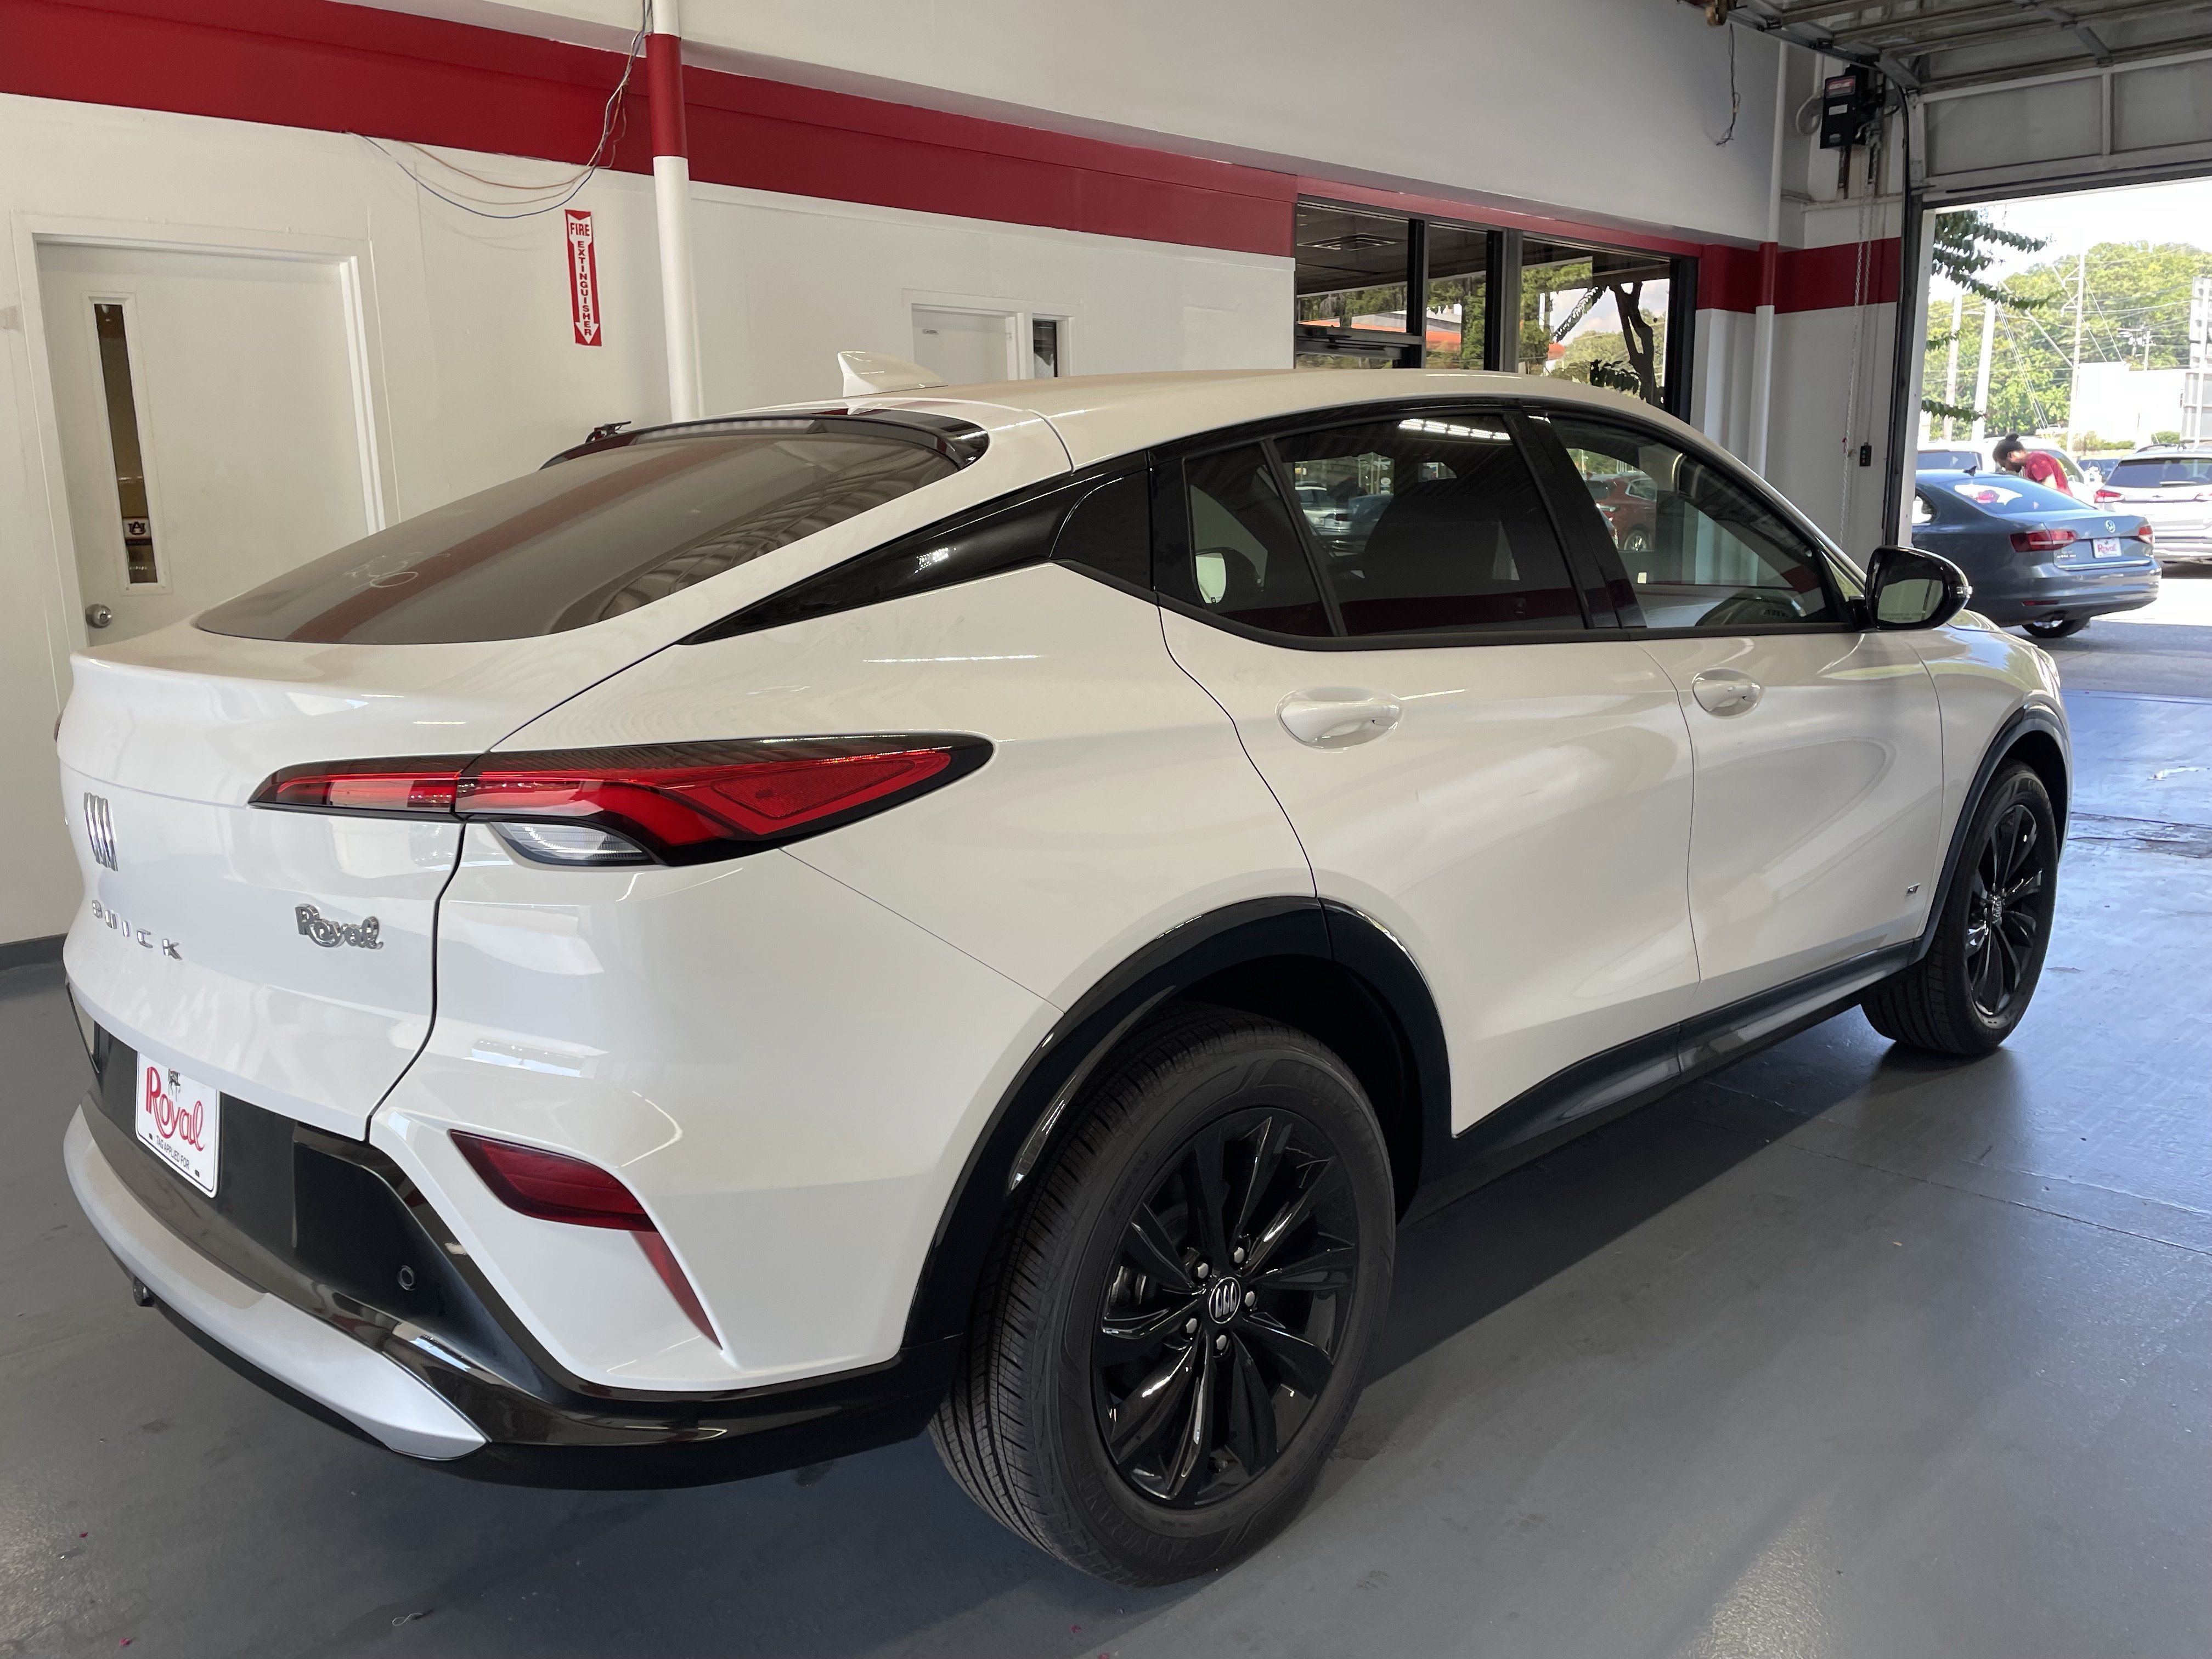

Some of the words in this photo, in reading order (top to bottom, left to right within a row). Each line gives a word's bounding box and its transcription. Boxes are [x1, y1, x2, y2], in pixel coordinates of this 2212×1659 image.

[570, 223, 590, 236] FIRE
[578, 241, 591, 336] EXTINGUISHER
[92, 900, 182, 960] BUICK
[295, 904, 383, 949] Royal
[146, 1066, 205, 1152] Royal
[164, 1142, 180, 1163] APPLIED
[180, 1155, 189, 1170] FOR
